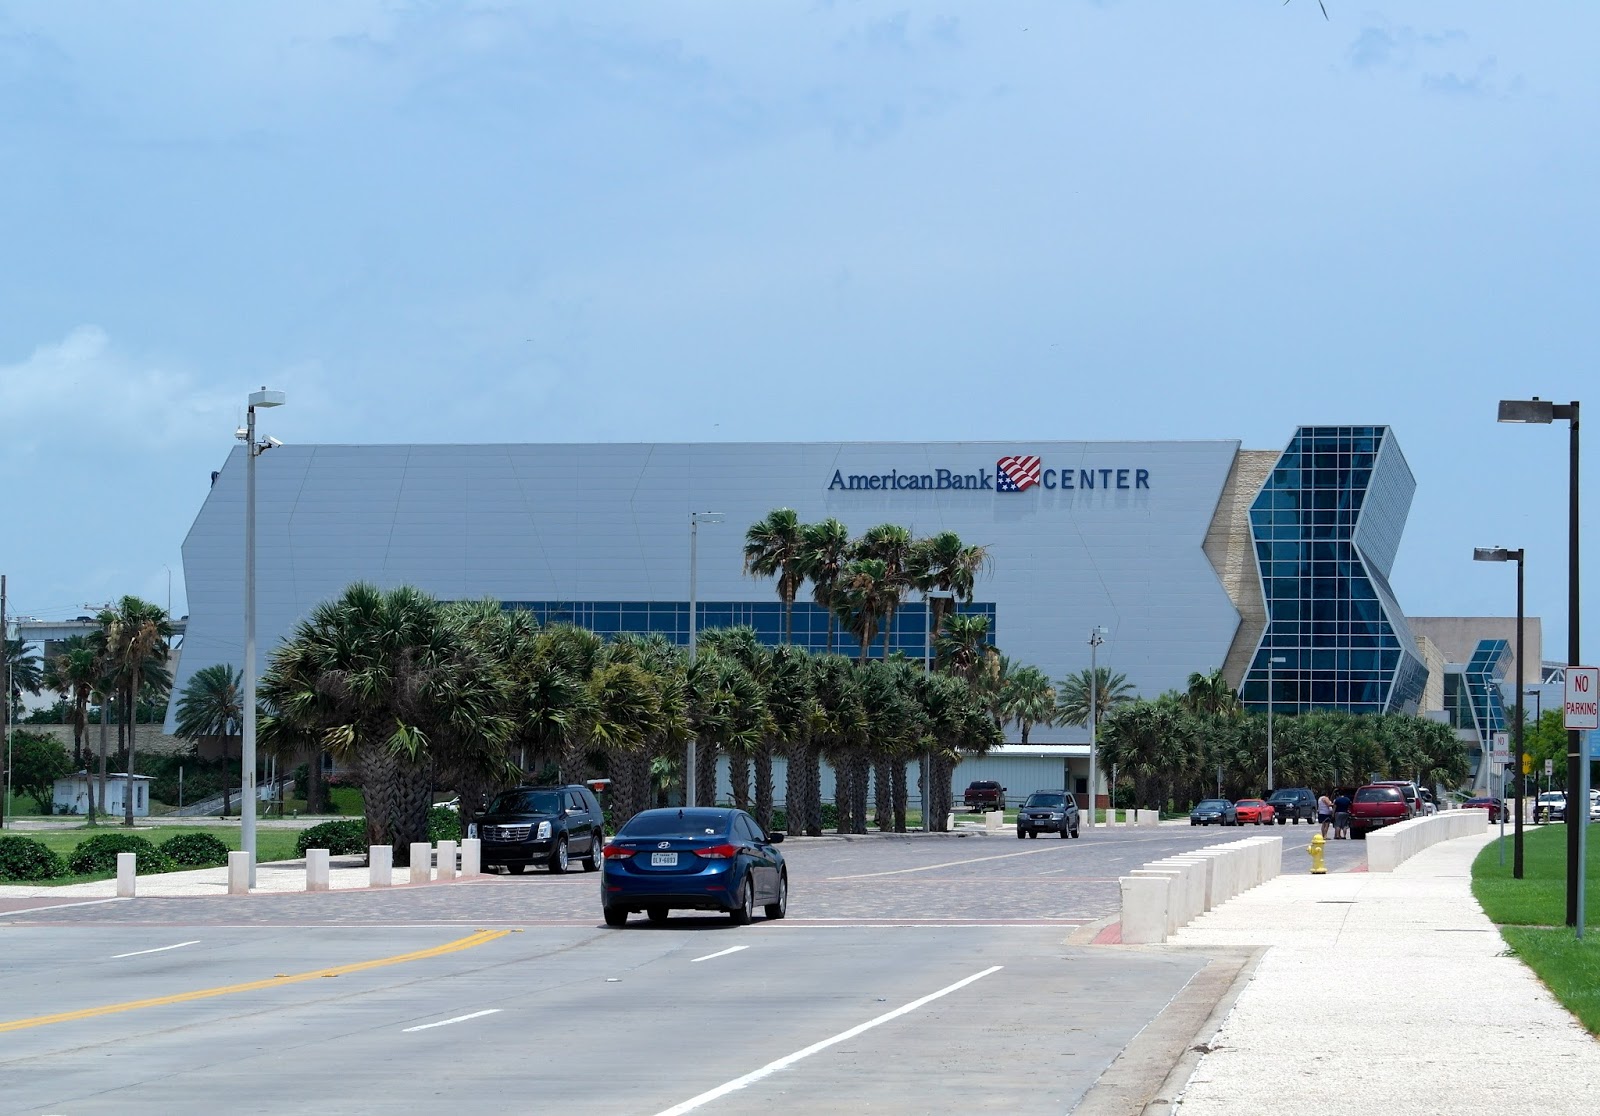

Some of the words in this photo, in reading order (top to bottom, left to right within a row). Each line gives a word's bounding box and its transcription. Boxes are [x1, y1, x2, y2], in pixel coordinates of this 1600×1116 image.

[828, 469, 993, 490] AmericanBank
[1043, 469, 1150, 490] CENTER
[1575, 676, 1588, 692] NO
[1566, 702, 1596, 715] PARKING
[1497, 736, 1505, 746] NO
